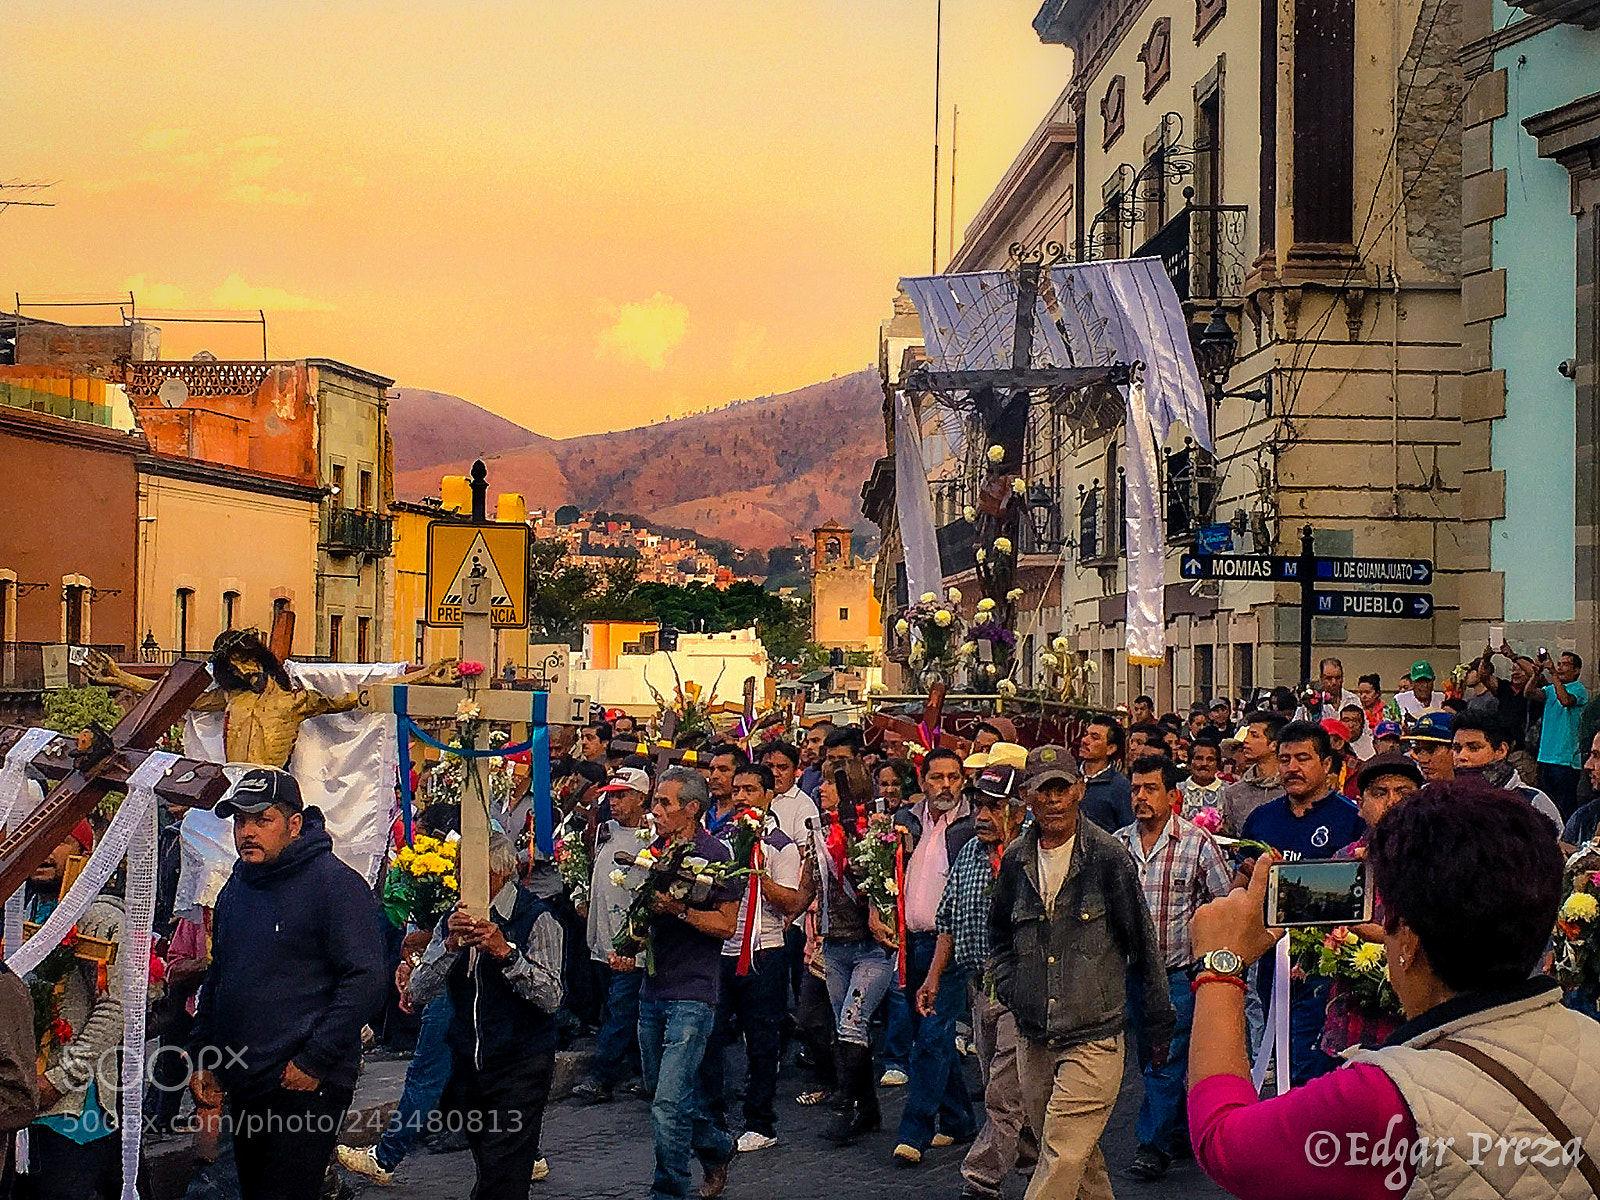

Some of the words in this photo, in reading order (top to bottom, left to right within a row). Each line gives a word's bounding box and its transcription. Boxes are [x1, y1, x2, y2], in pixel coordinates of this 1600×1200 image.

[1212, 559, 1272, 577] MOMIAS
[1333, 562, 1342, 578] U.
[1343, 562, 1356, 578] DE
[1356, 562, 1413, 579] GUANAJUATO
[467, 583, 481, 605] J
[1343, 596, 1404, 613] PUEBLO
[437, 607, 517, 622] PRENCIA
